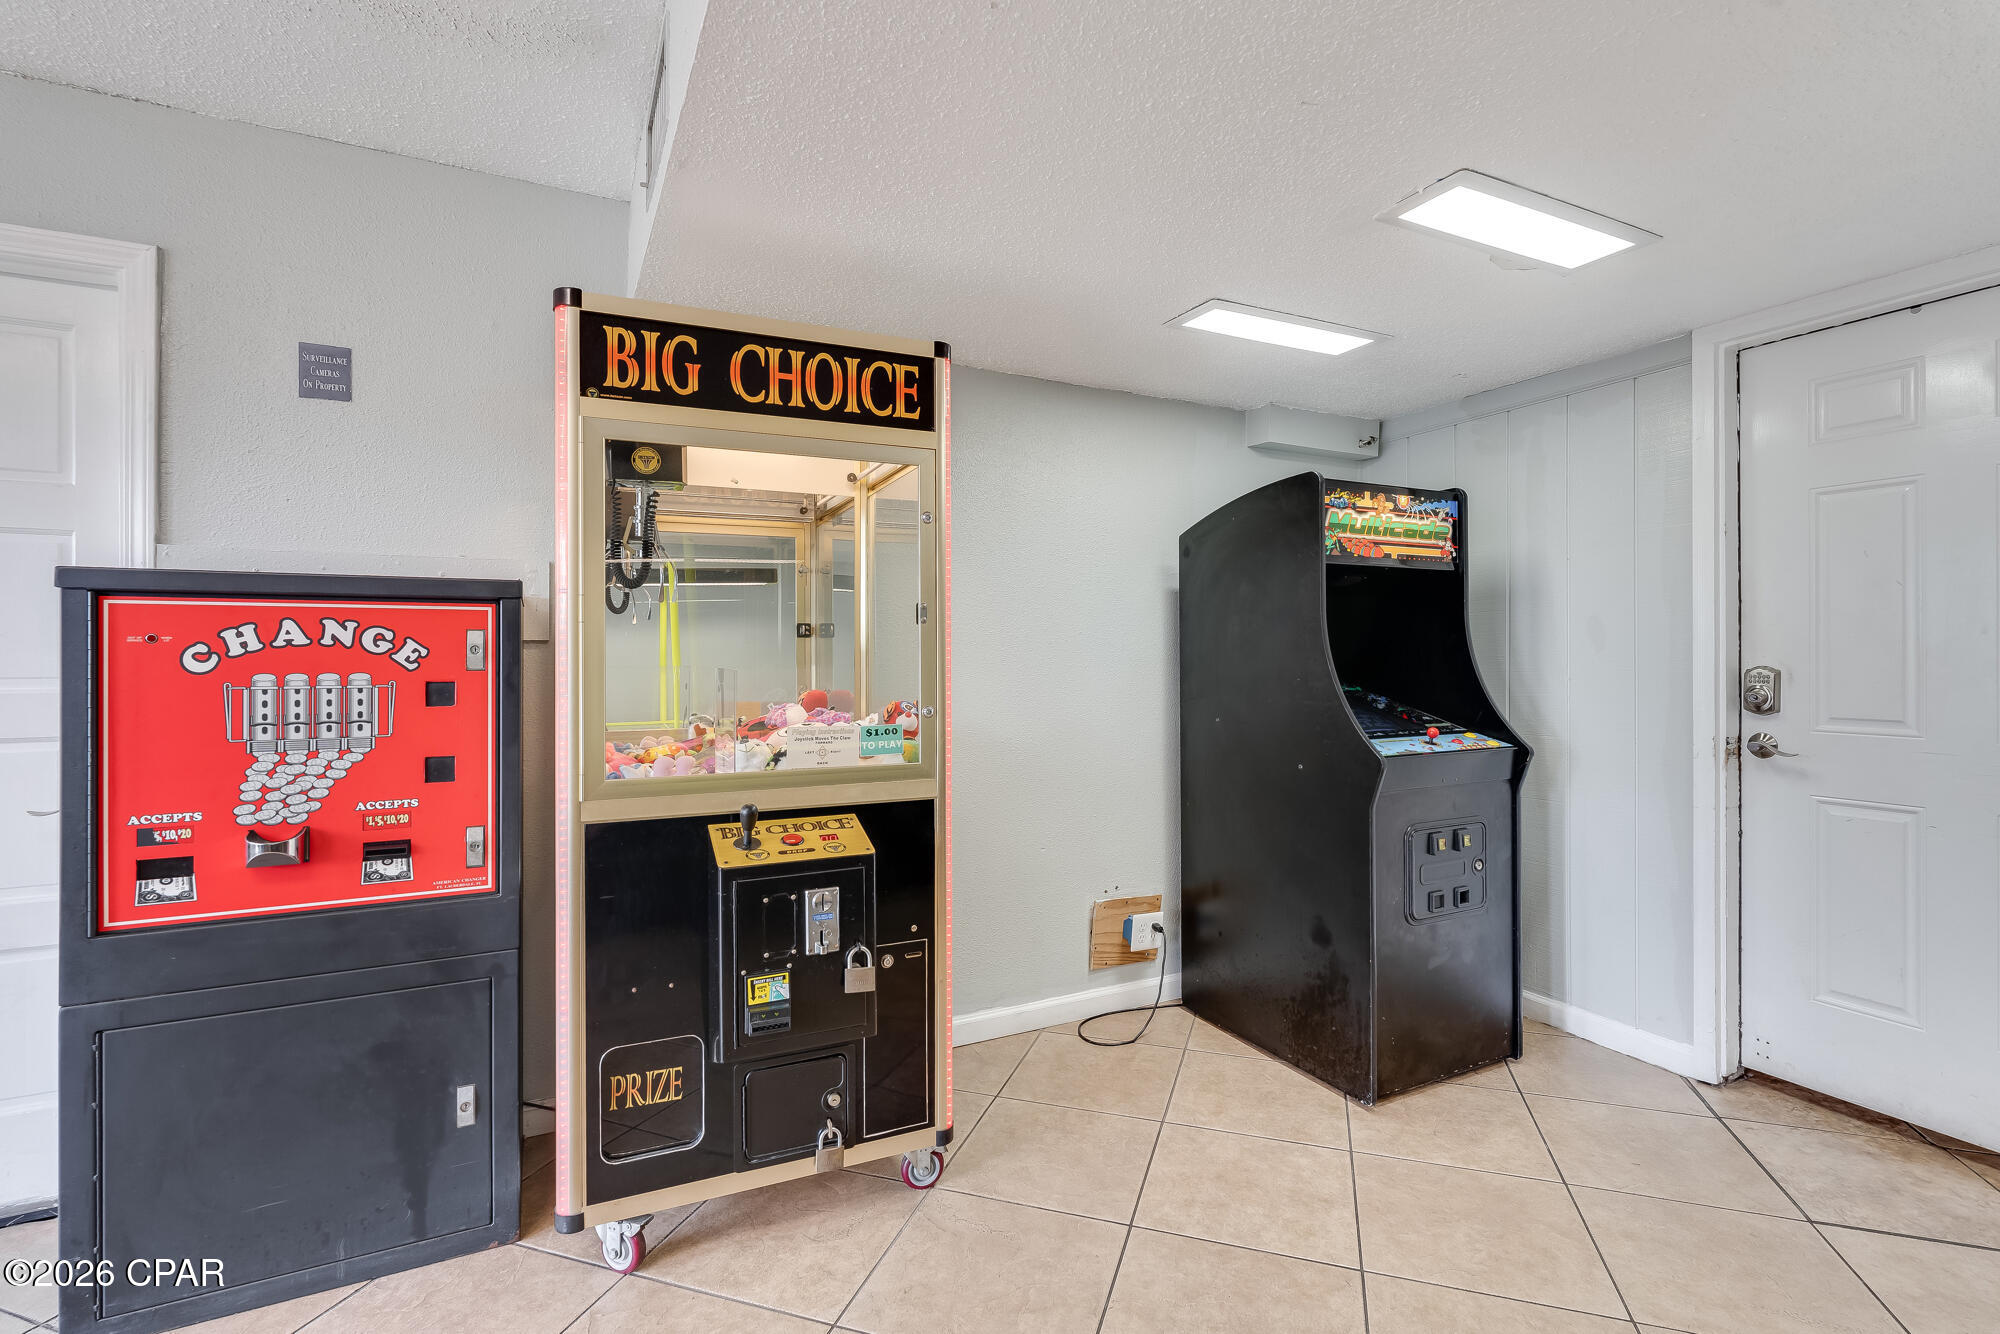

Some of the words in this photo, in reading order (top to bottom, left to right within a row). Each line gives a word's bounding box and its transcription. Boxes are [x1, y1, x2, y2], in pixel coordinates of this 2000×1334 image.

[602, 325, 701, 396] BIG
[730, 344, 921, 420] CHOICE
[1328, 511, 1450, 540] Multicade
[181, 617, 430, 674] CHANGE
[865, 727, 899, 738] $1.00
[861, 741, 876, 750] TO
[878, 740, 903, 750] PLAY
[355, 798, 419, 811] ACCEPTS
[127, 811, 203, 826] ACCEPTS
[765, 817, 854, 834] CHOICE
[608, 1065, 684, 1111] PRIZE
